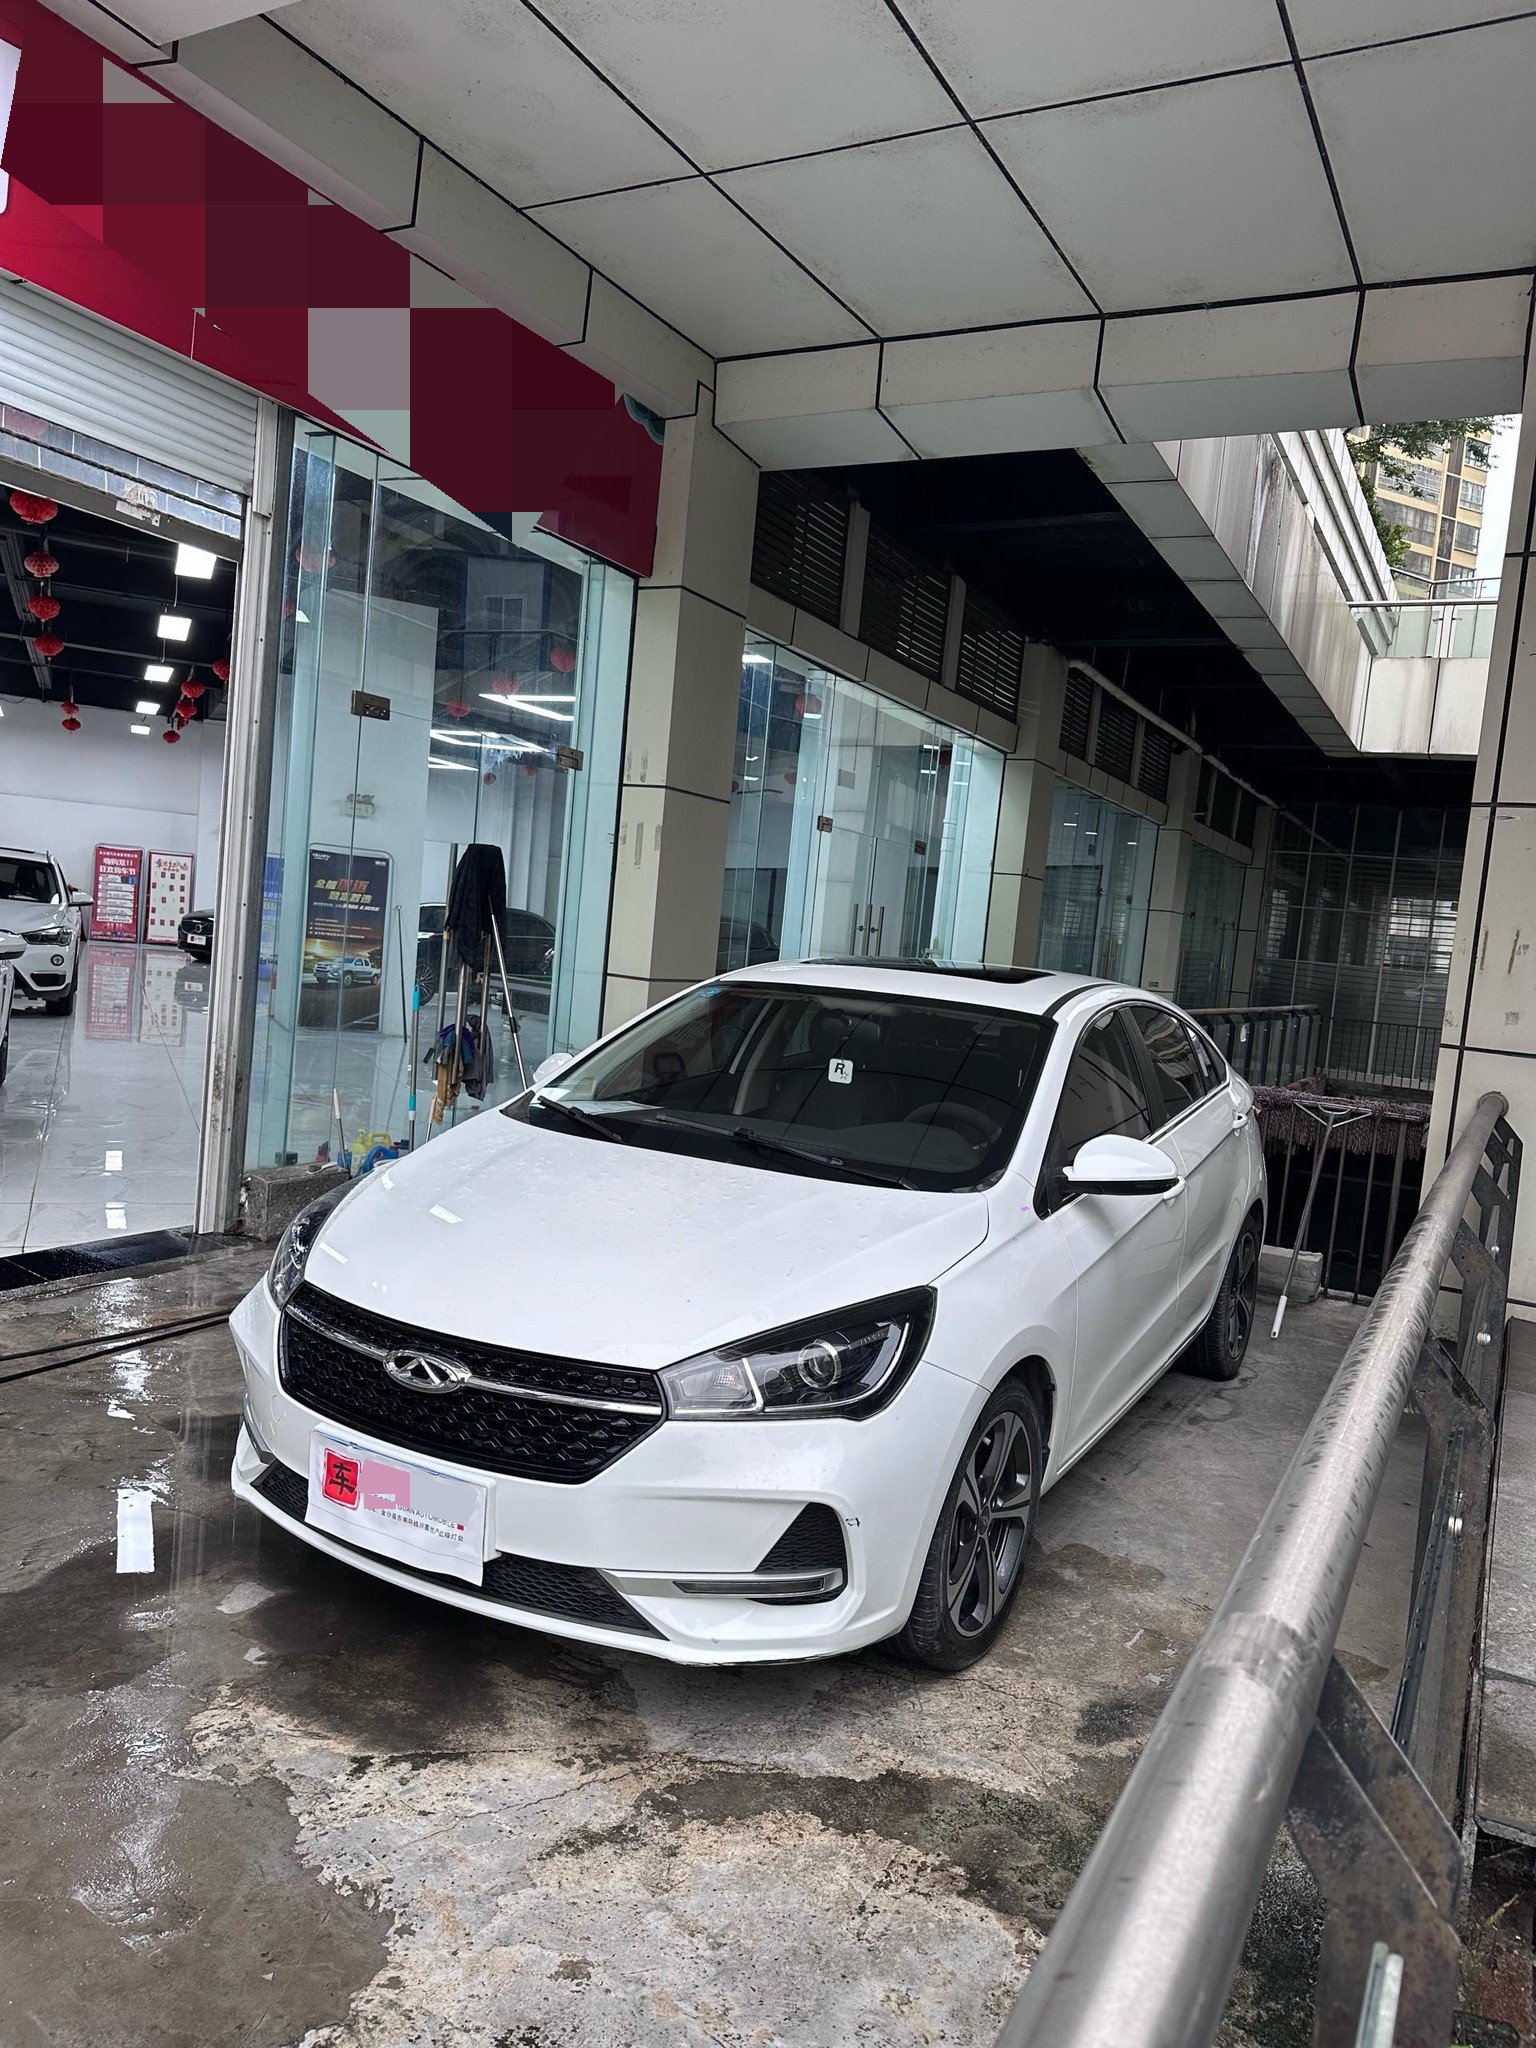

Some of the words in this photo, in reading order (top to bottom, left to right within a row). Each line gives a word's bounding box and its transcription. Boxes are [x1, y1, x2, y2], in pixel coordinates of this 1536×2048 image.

[99, 866, 136, 875] 狂欢购车节
[834, 1063, 845, 1075] R
[329, 1461, 355, 1495] 车
[415, 1510, 456, 1529] AUTOMOBE
